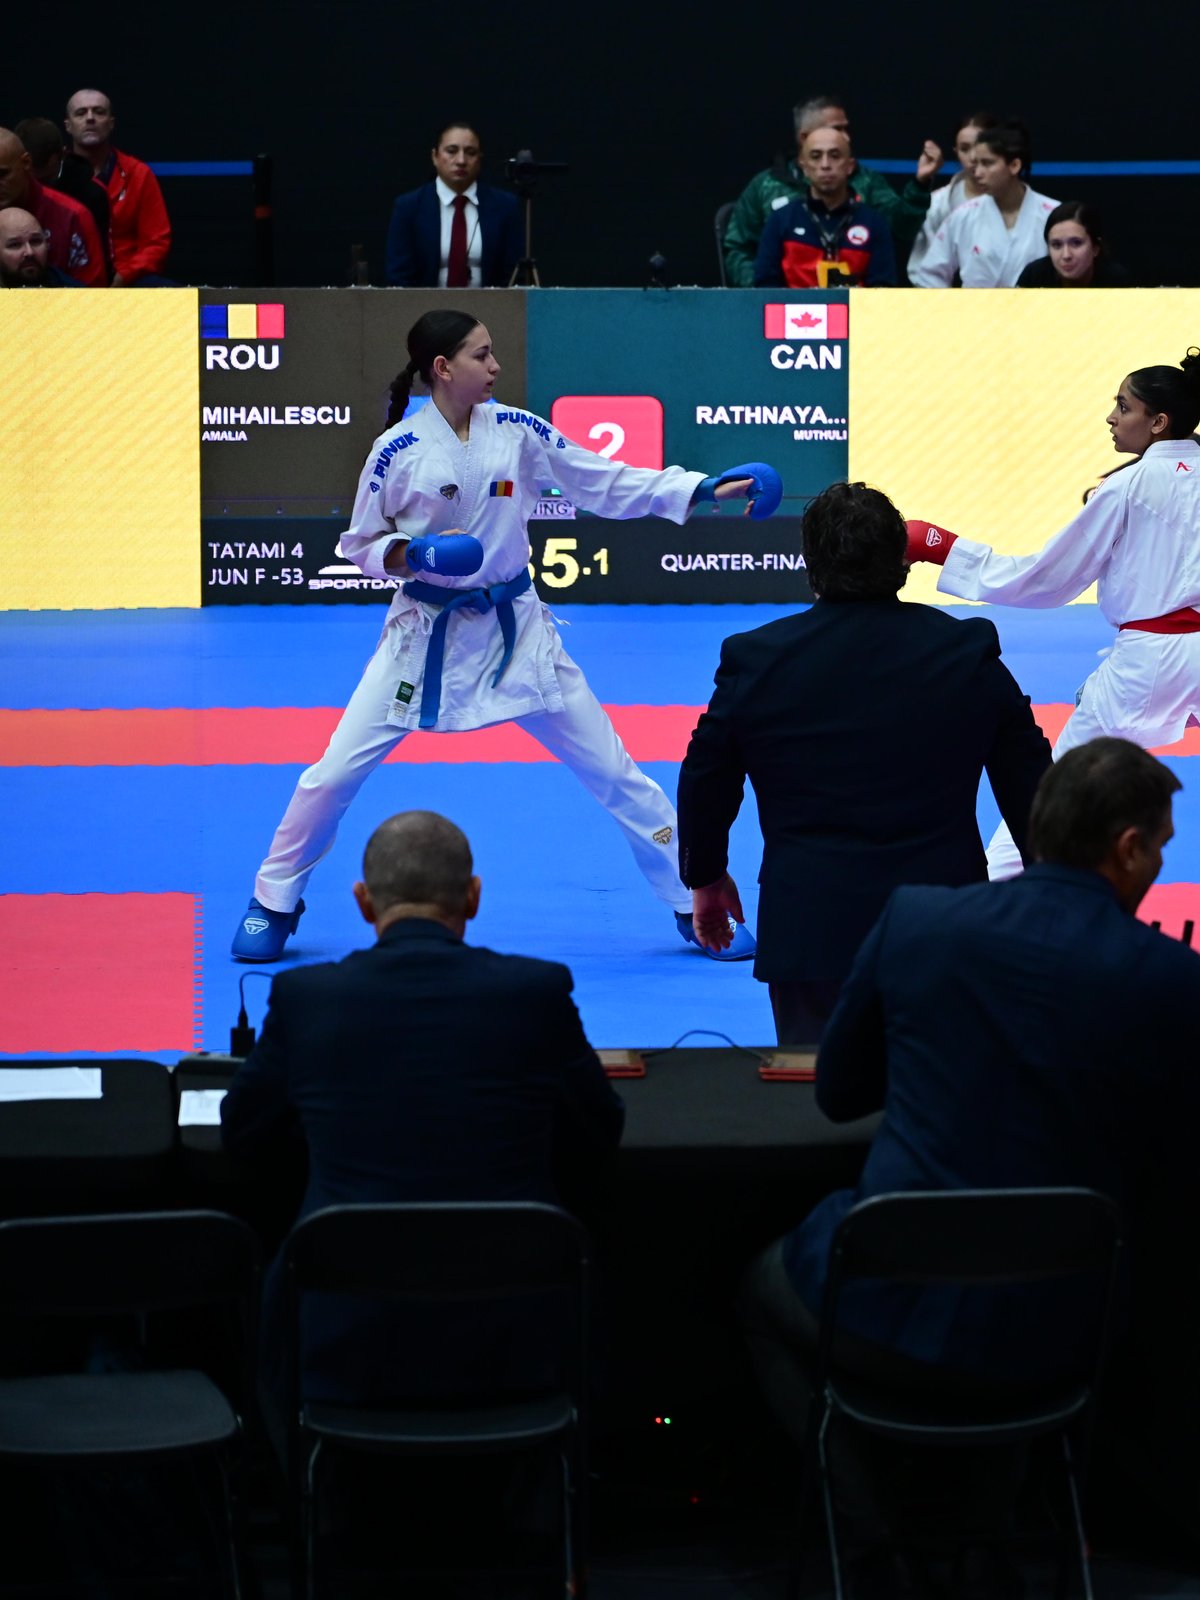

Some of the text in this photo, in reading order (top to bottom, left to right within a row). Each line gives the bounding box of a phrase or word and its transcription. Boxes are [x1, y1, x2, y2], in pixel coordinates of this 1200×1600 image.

[205, 345, 280, 370] ROU
[770, 344, 842, 369] CAN
[202, 406, 351, 425] MIHAILESCU
[696, 405, 846, 425] RATHNAYA...
[201, 430, 248, 441] AMALIA
[496, 411, 552, 441] PUNOK
[793, 429, 848, 441] MUTHULI
[587, 421, 625, 464] 2
[373, 431, 420, 479] PUNOK
[208, 541, 304, 559] TATAMI 4
[527, 537, 609, 589] 5.1
[660, 553, 807, 573] QUARTER-FINA
[208, 567, 304, 585] JUN F -53
[308, 578, 406, 590] SPORTDAT
